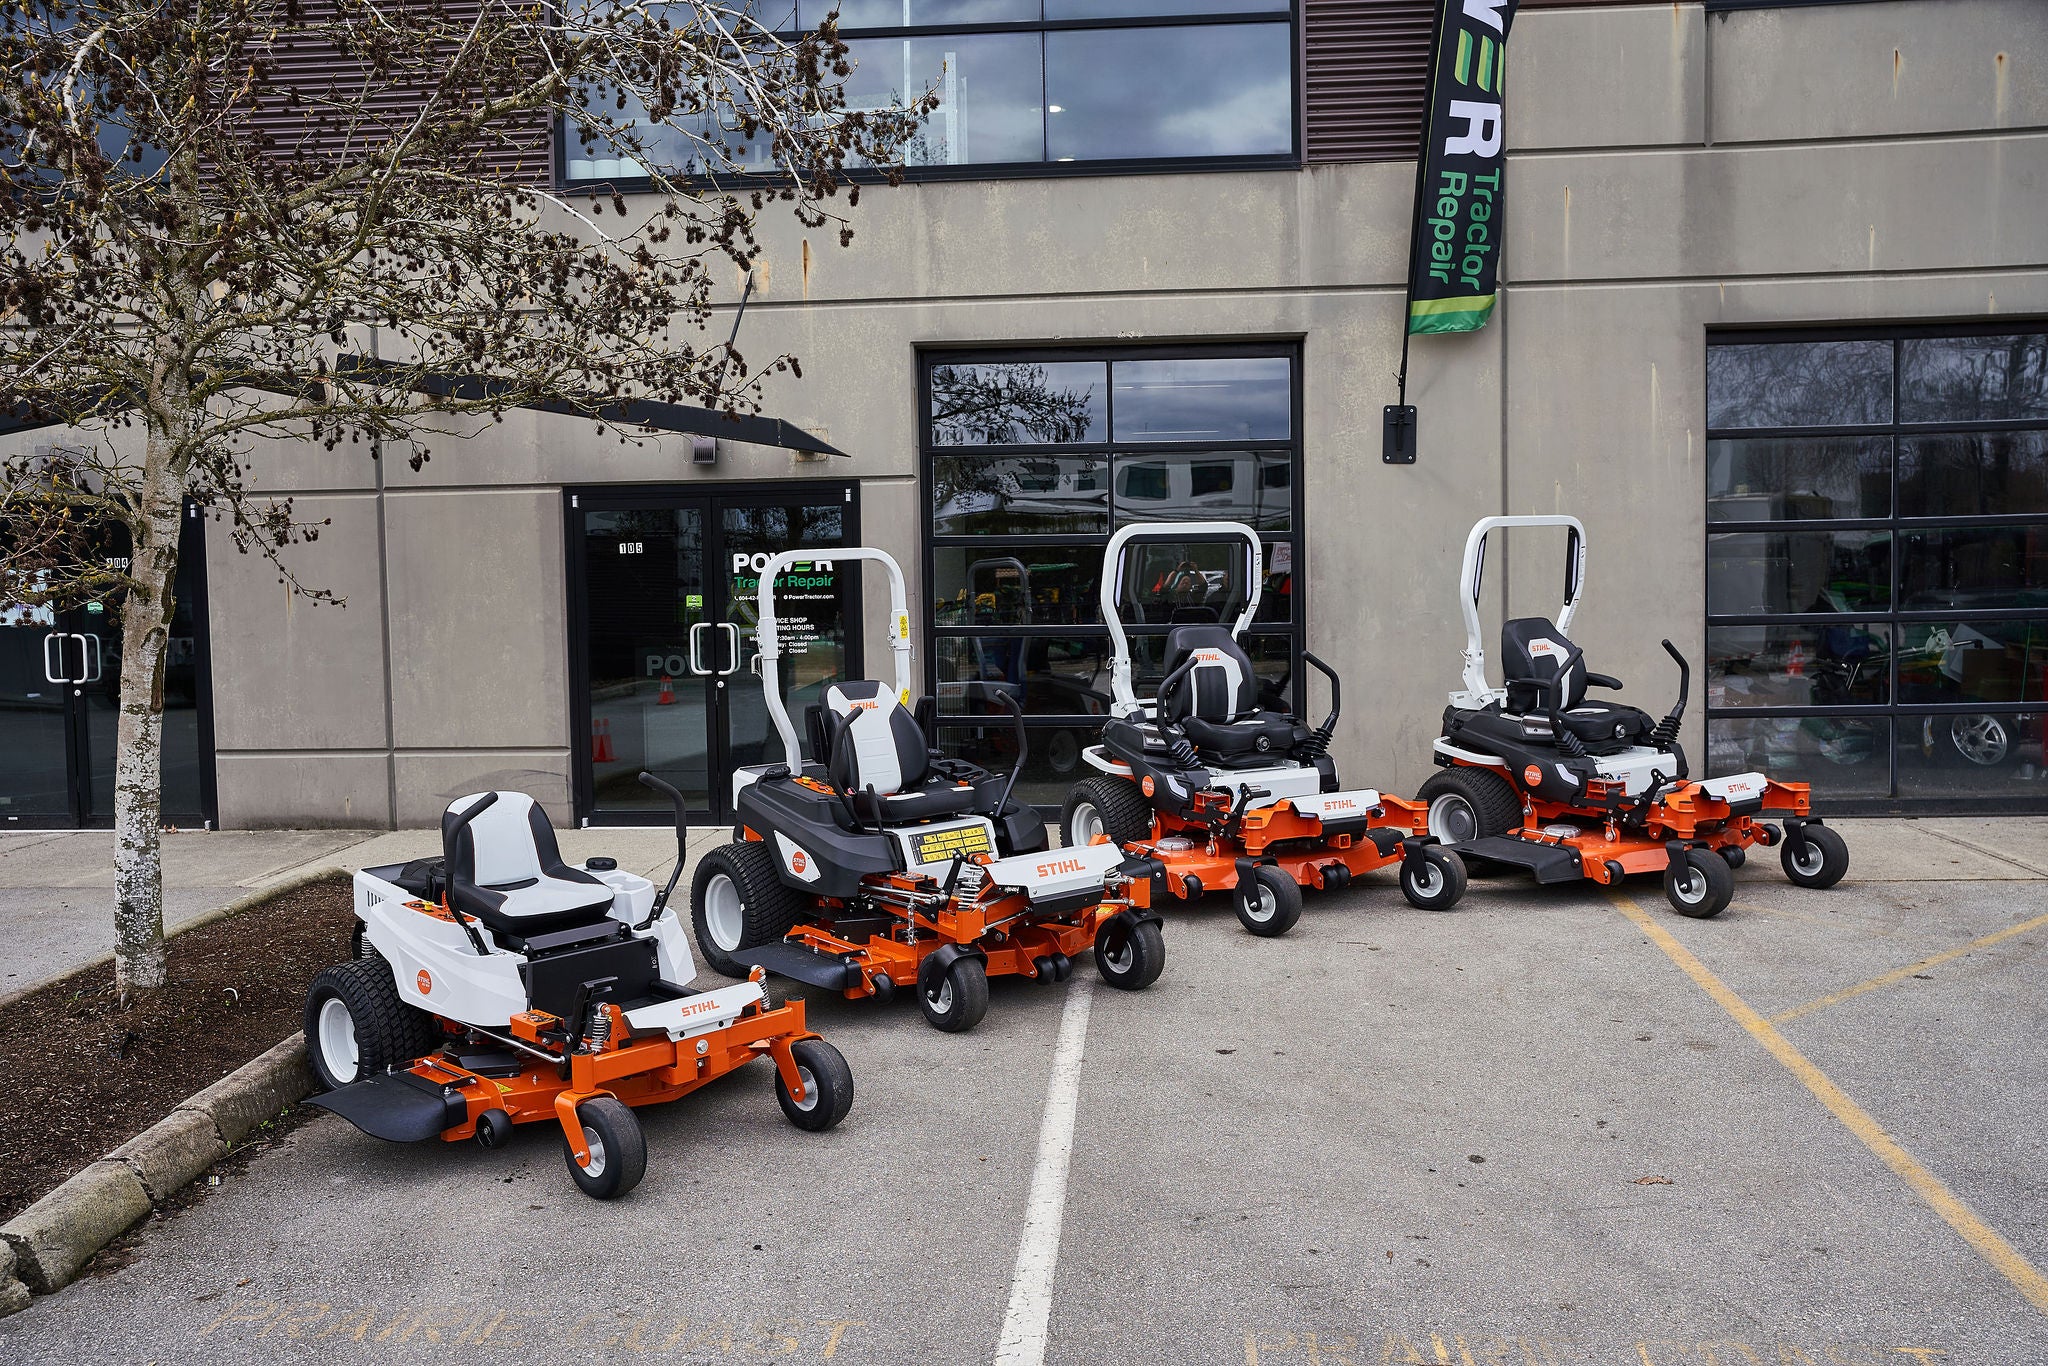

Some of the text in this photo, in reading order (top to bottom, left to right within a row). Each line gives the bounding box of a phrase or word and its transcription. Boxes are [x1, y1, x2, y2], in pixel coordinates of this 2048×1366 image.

[1428, 171, 1468, 285] Repair
[1460, 167, 1500, 291] Tractor
[620, 543, 643, 554] 105
[788, 574, 834, 590] Repair
[1531, 643, 1551, 652] STIHL
[1195, 653, 1220, 661] STIHL
[1727, 782, 1751, 793] STIHL
[1324, 799, 1357, 811] STIHL
[1036, 859, 1086, 878] STIHL
[681, 999, 720, 1017] STIHL
